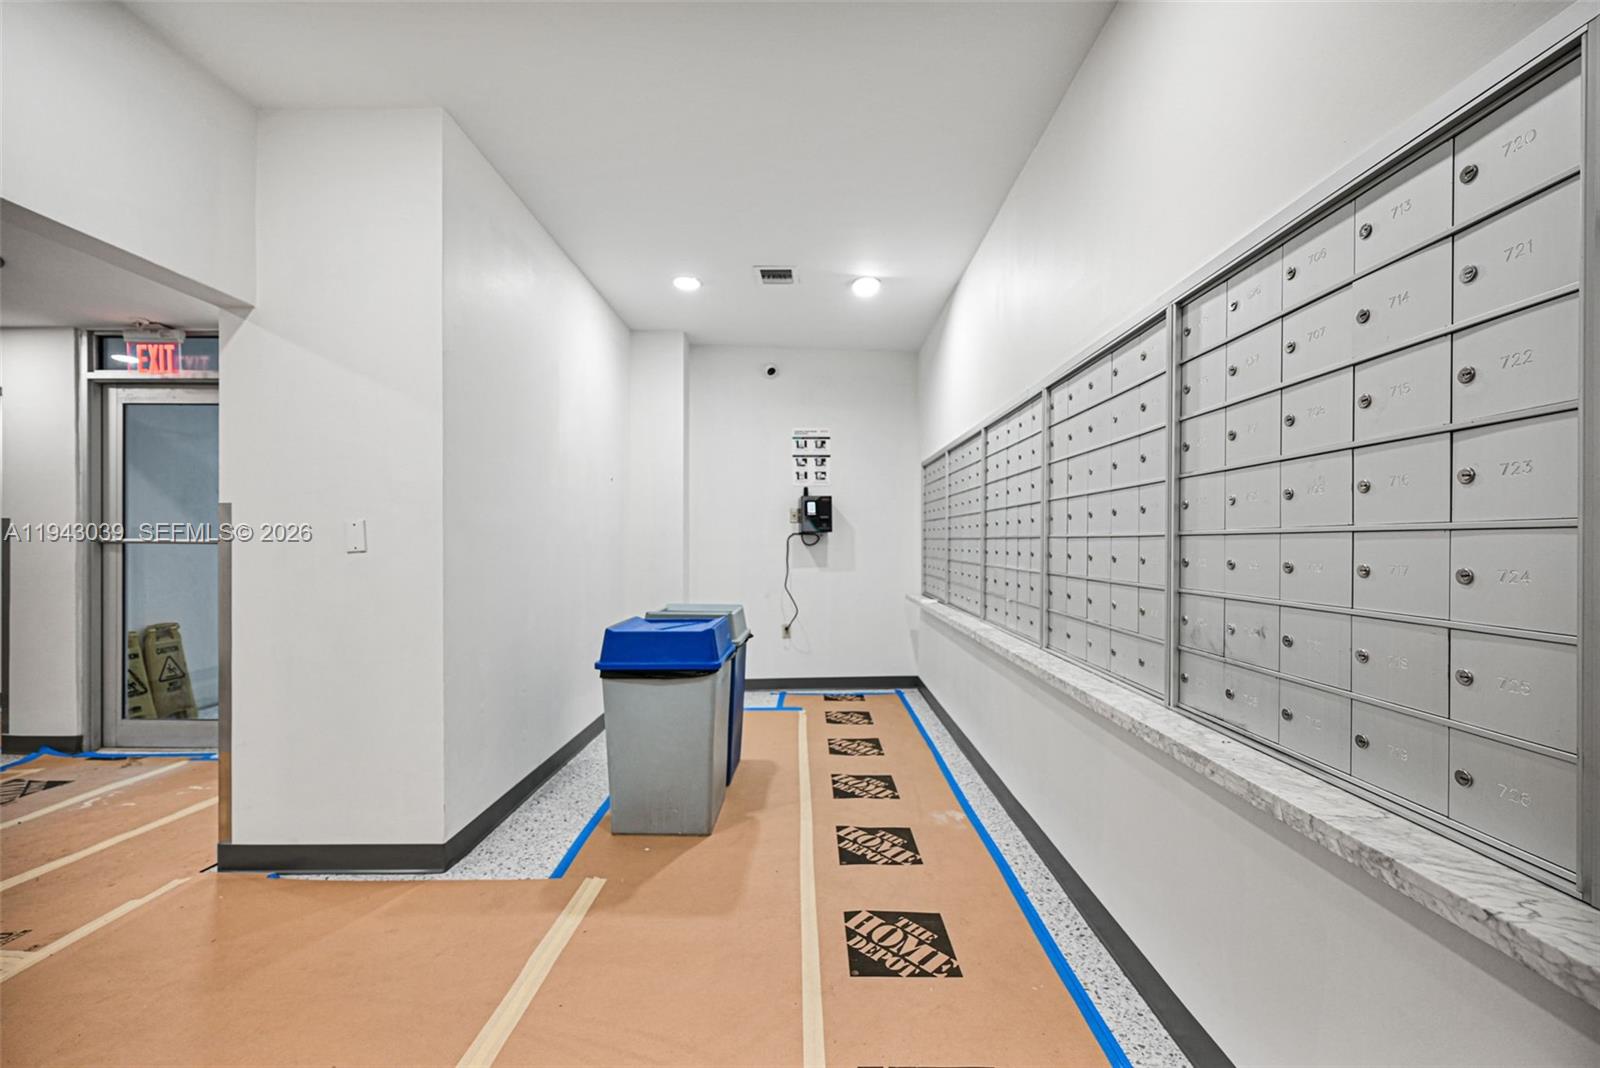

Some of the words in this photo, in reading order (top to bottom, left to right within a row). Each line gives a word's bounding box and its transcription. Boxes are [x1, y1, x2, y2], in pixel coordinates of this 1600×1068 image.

[1502, 127, 1537, 158] 720
[1390, 198, 1413, 219] 713
[1504, 238, 1534, 263] 721
[1389, 290, 1410, 309] 714
[1307, 326, 1327, 342] 707
[136, 343, 175, 375] EXIT
[1500, 349, 1535, 369] 722
[1389, 382, 1411, 397] 715
[1498, 459, 1533, 477] 723
[1389, 473, 1410, 488] 716
[1389, 564, 1410, 577] 717
[1497, 568, 1532, 585] 724
[837, 826, 922, 866] HOME
[875, 830, 908, 847] THE
[838, 839, 893, 866] DEPOT
[895, 916, 938, 944] THE
[844, 910, 960, 978] HOME
[846, 934, 921, 978] DEPOT
